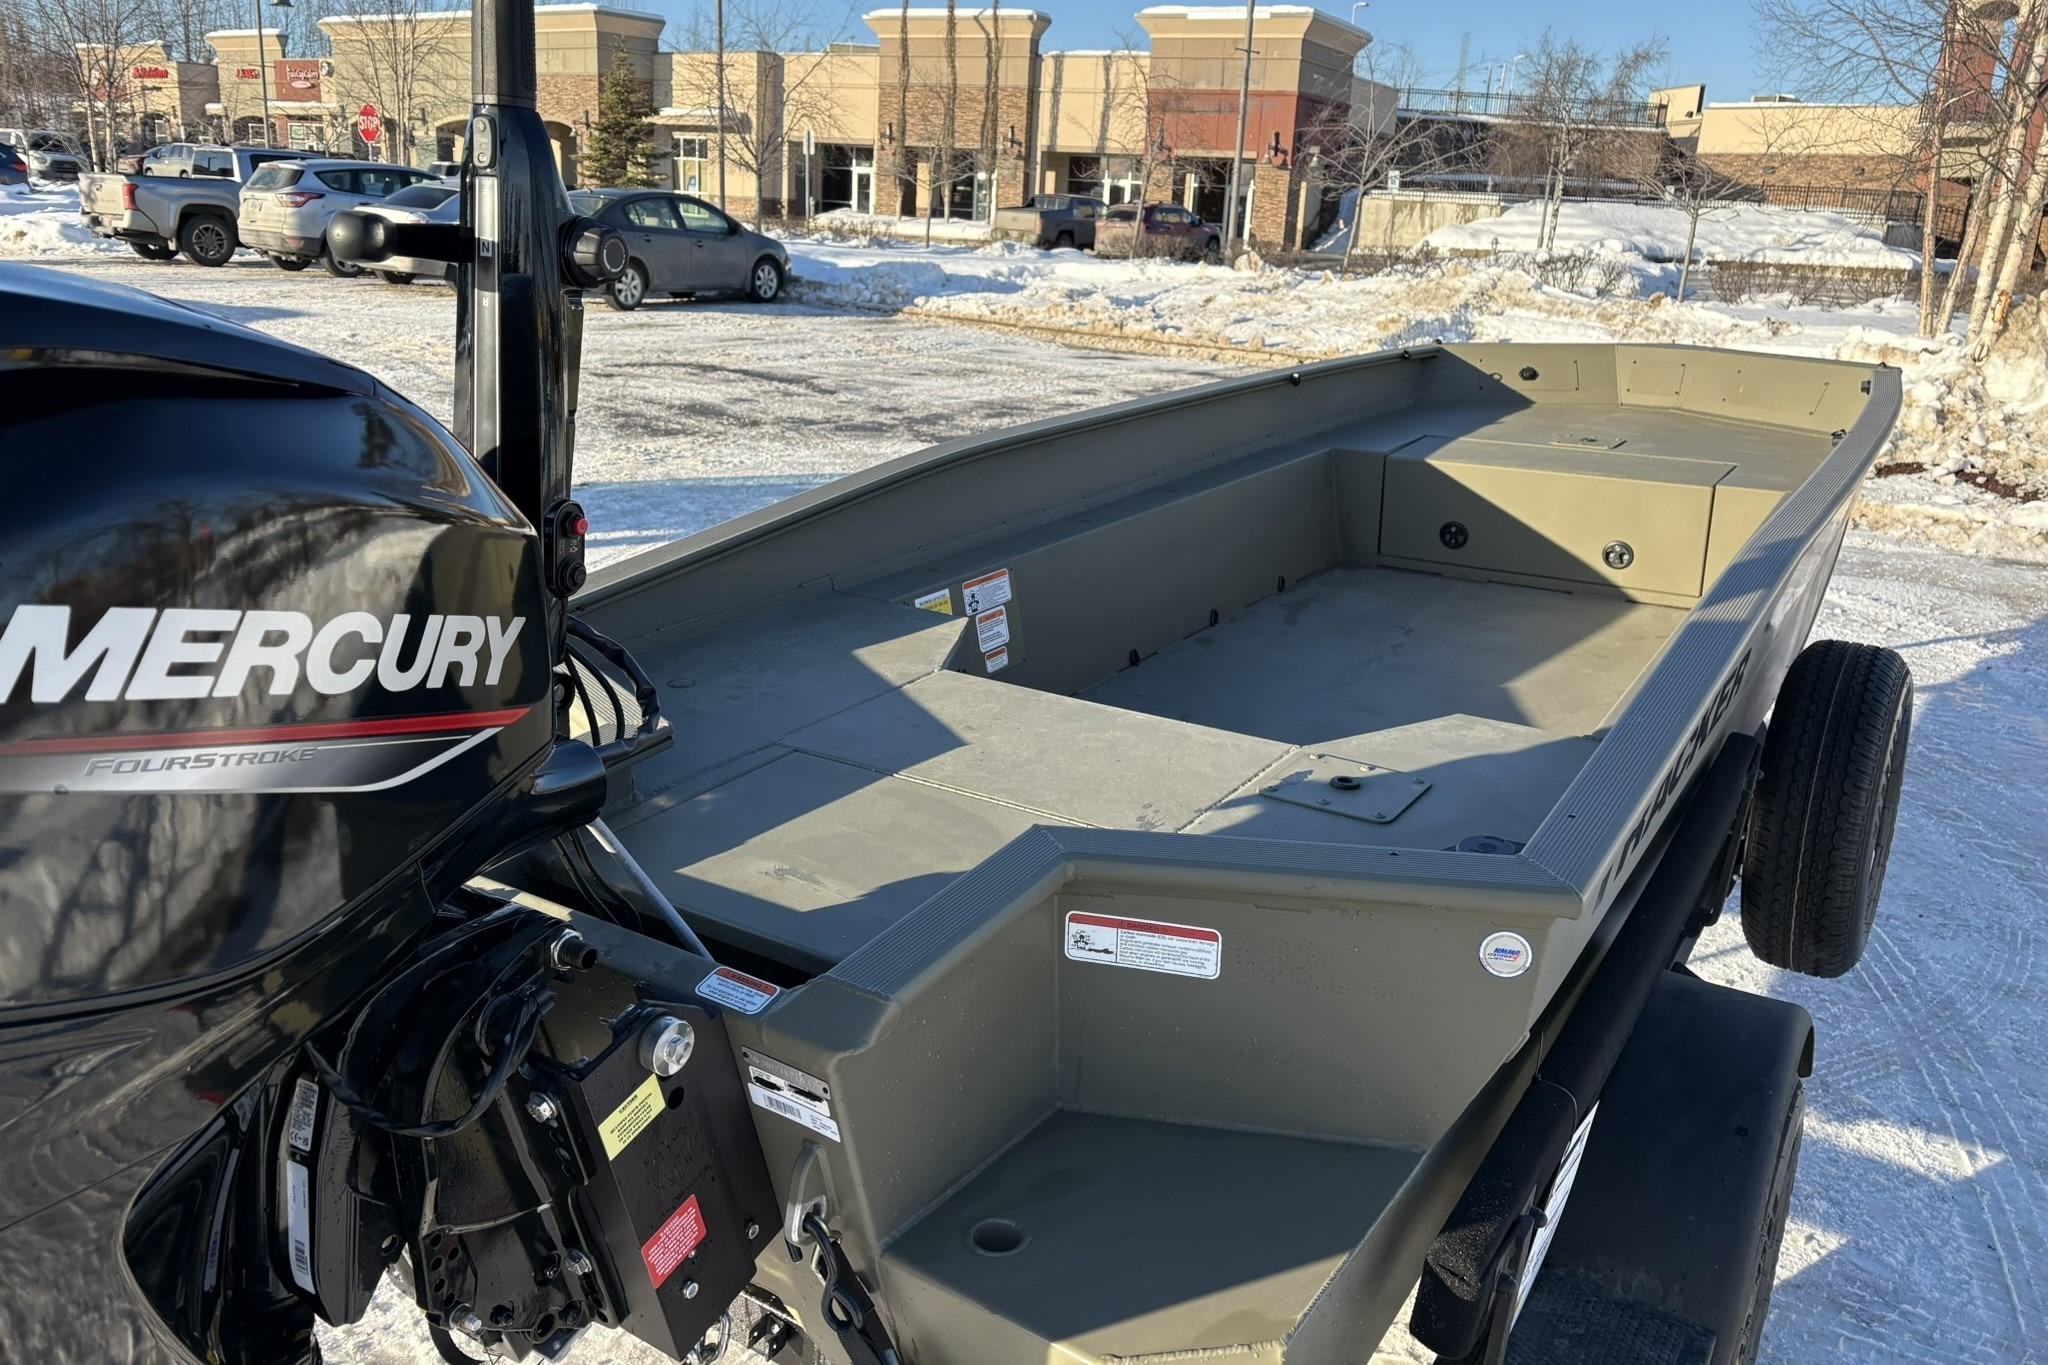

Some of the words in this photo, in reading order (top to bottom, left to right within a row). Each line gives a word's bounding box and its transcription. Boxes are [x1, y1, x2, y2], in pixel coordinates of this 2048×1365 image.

[360, 116, 378, 130] STOP
[482, 241, 490, 253] N
[0, 604, 526, 703] MERCURY
[1592, 647, 1752, 914] TRACKER
